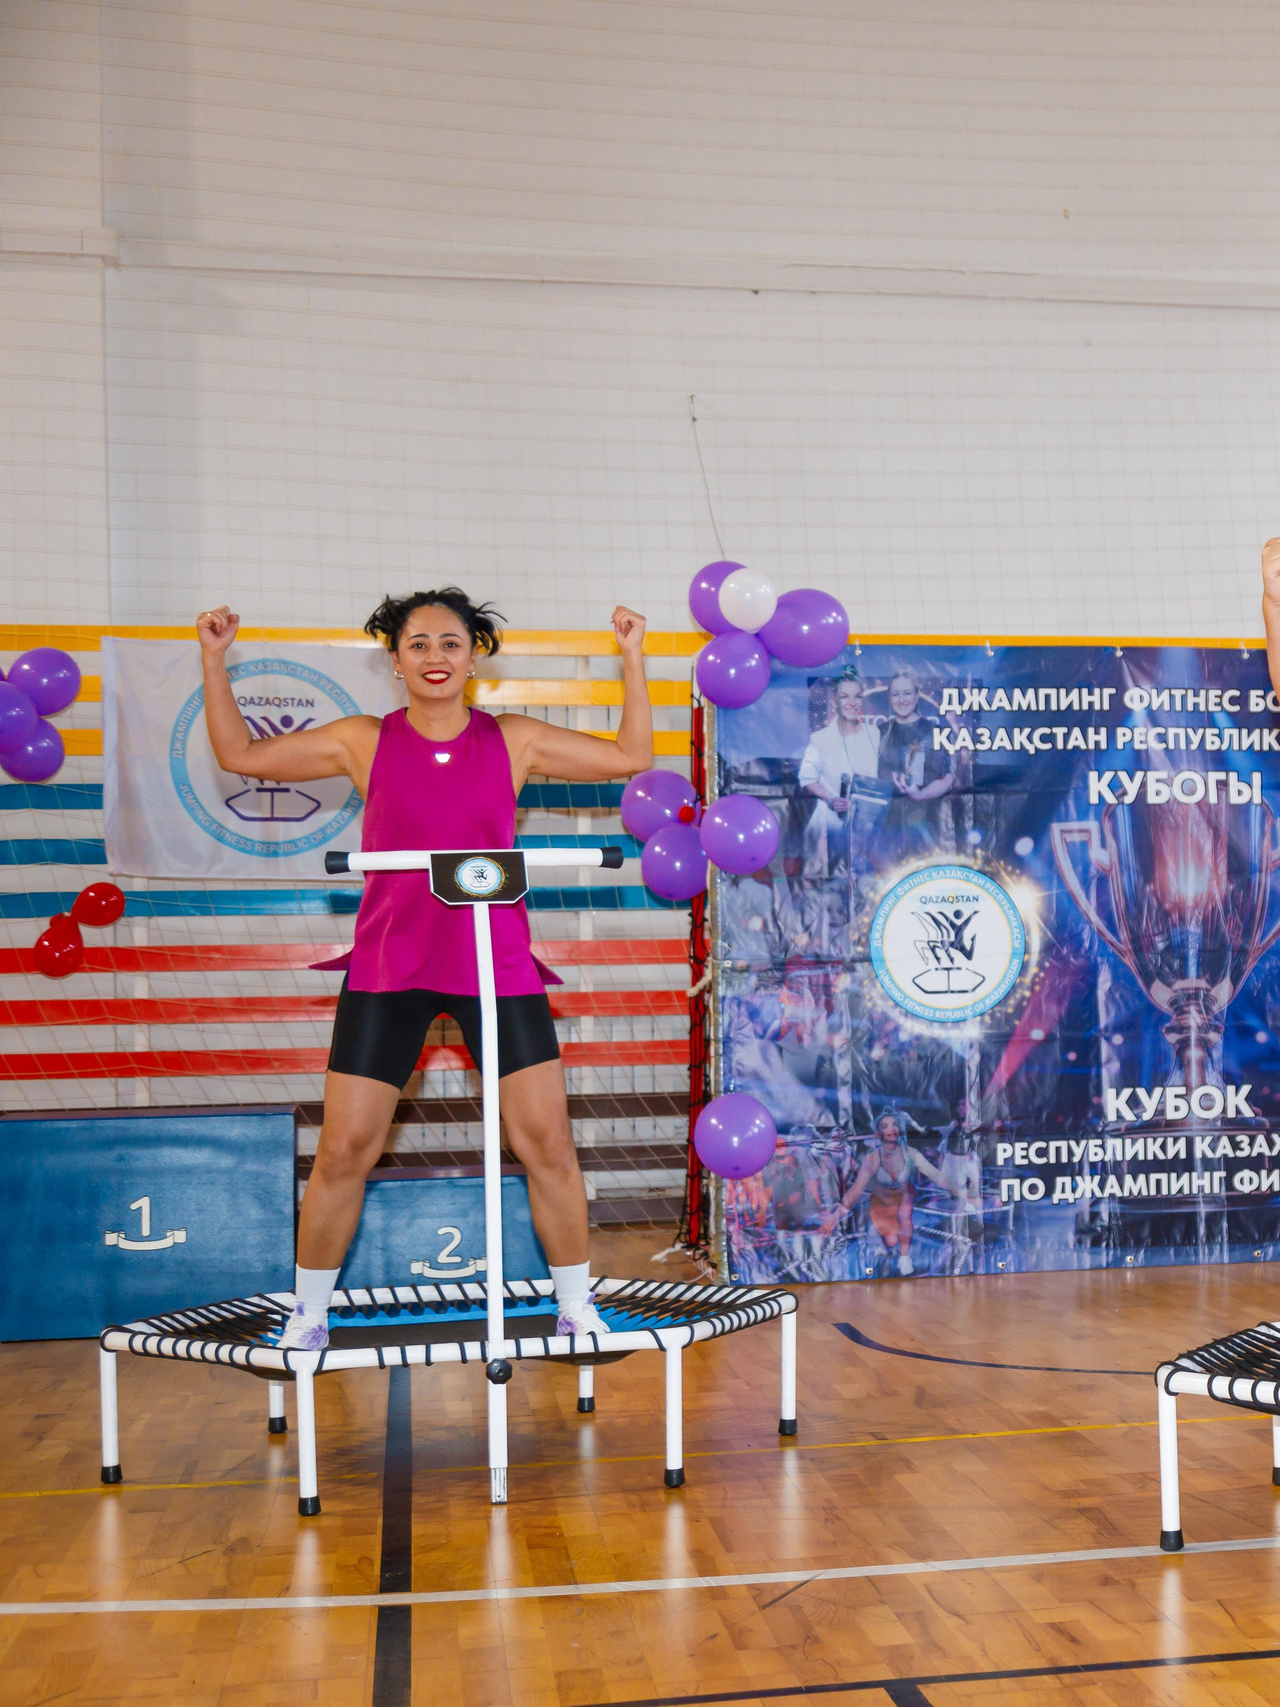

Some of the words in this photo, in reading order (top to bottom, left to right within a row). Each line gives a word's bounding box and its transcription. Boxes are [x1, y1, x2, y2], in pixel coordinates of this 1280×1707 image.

[237, 696, 315, 708] QAZAQSTAN
[939, 687, 1117, 715] ДЖАМПИНГ
[1123, 686, 1241, 713] ФИТНЕС
[172, 693, 204, 759] ДЖАМПИНГ
[932, 727, 1108, 754] ҚАЗАҚСТАН
[1088, 771, 1262, 805] КУБОГЫ
[179, 783, 212, 826] JUMPING
[211, 822, 253, 850] FITNESS
[254, 838, 310, 853] REPUBLIC
[310, 831, 324, 844] OF
[873, 897, 898, 947] ДЖАМПИНГ
[896, 872, 931, 896] ФИТНЕС
[932, 869, 986, 886] ҚАЗАҚСТАН
[985, 882, 1022, 947] РЕСПУБЛИКАСЫ
[919, 895, 980, 905] QAZAQSTAN
[879, 968, 906, 1001] JUMPING
[904, 998, 935, 1018] FITNESS
[935, 1009, 974, 1019] REPUBLIC
[974, 1003, 986, 1012] OF
[985, 958, 1020, 1007] KAZAKHSTAN
[1106, 1084, 1256, 1122] КУБОК
[996, 1136, 1187, 1166] РЕСПУБЛИКИ
[1001, 1177, 1046, 1203] ПО
[1052, 1170, 1227, 1204] ДЖАМПИНГ
[129, 1196, 151, 1237] 1
[436, 1226, 463, 1264] 2
